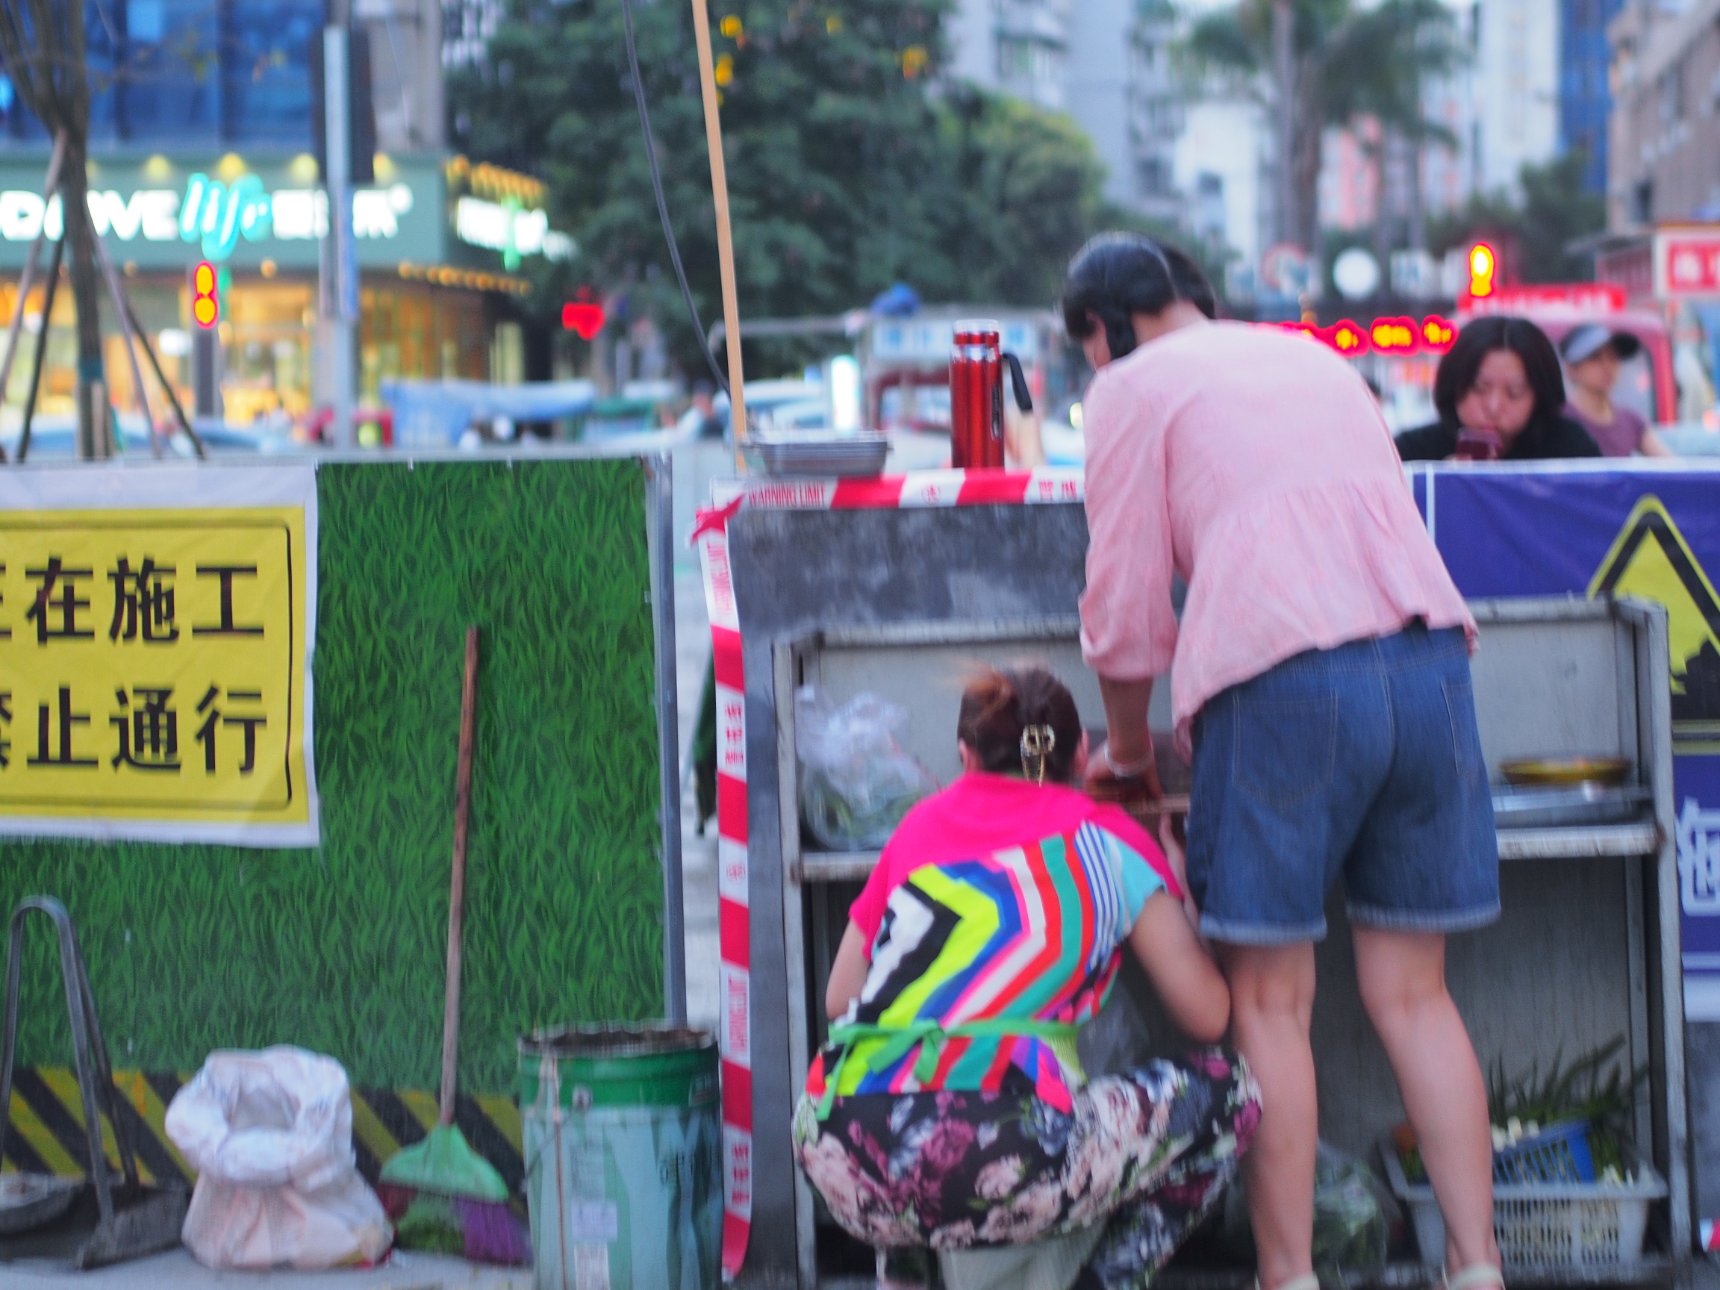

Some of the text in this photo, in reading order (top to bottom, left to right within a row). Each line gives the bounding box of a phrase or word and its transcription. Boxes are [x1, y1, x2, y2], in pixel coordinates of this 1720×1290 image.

[0, 554, 264, 645] 在施工
[0, 682, 267, 776] 止通行
